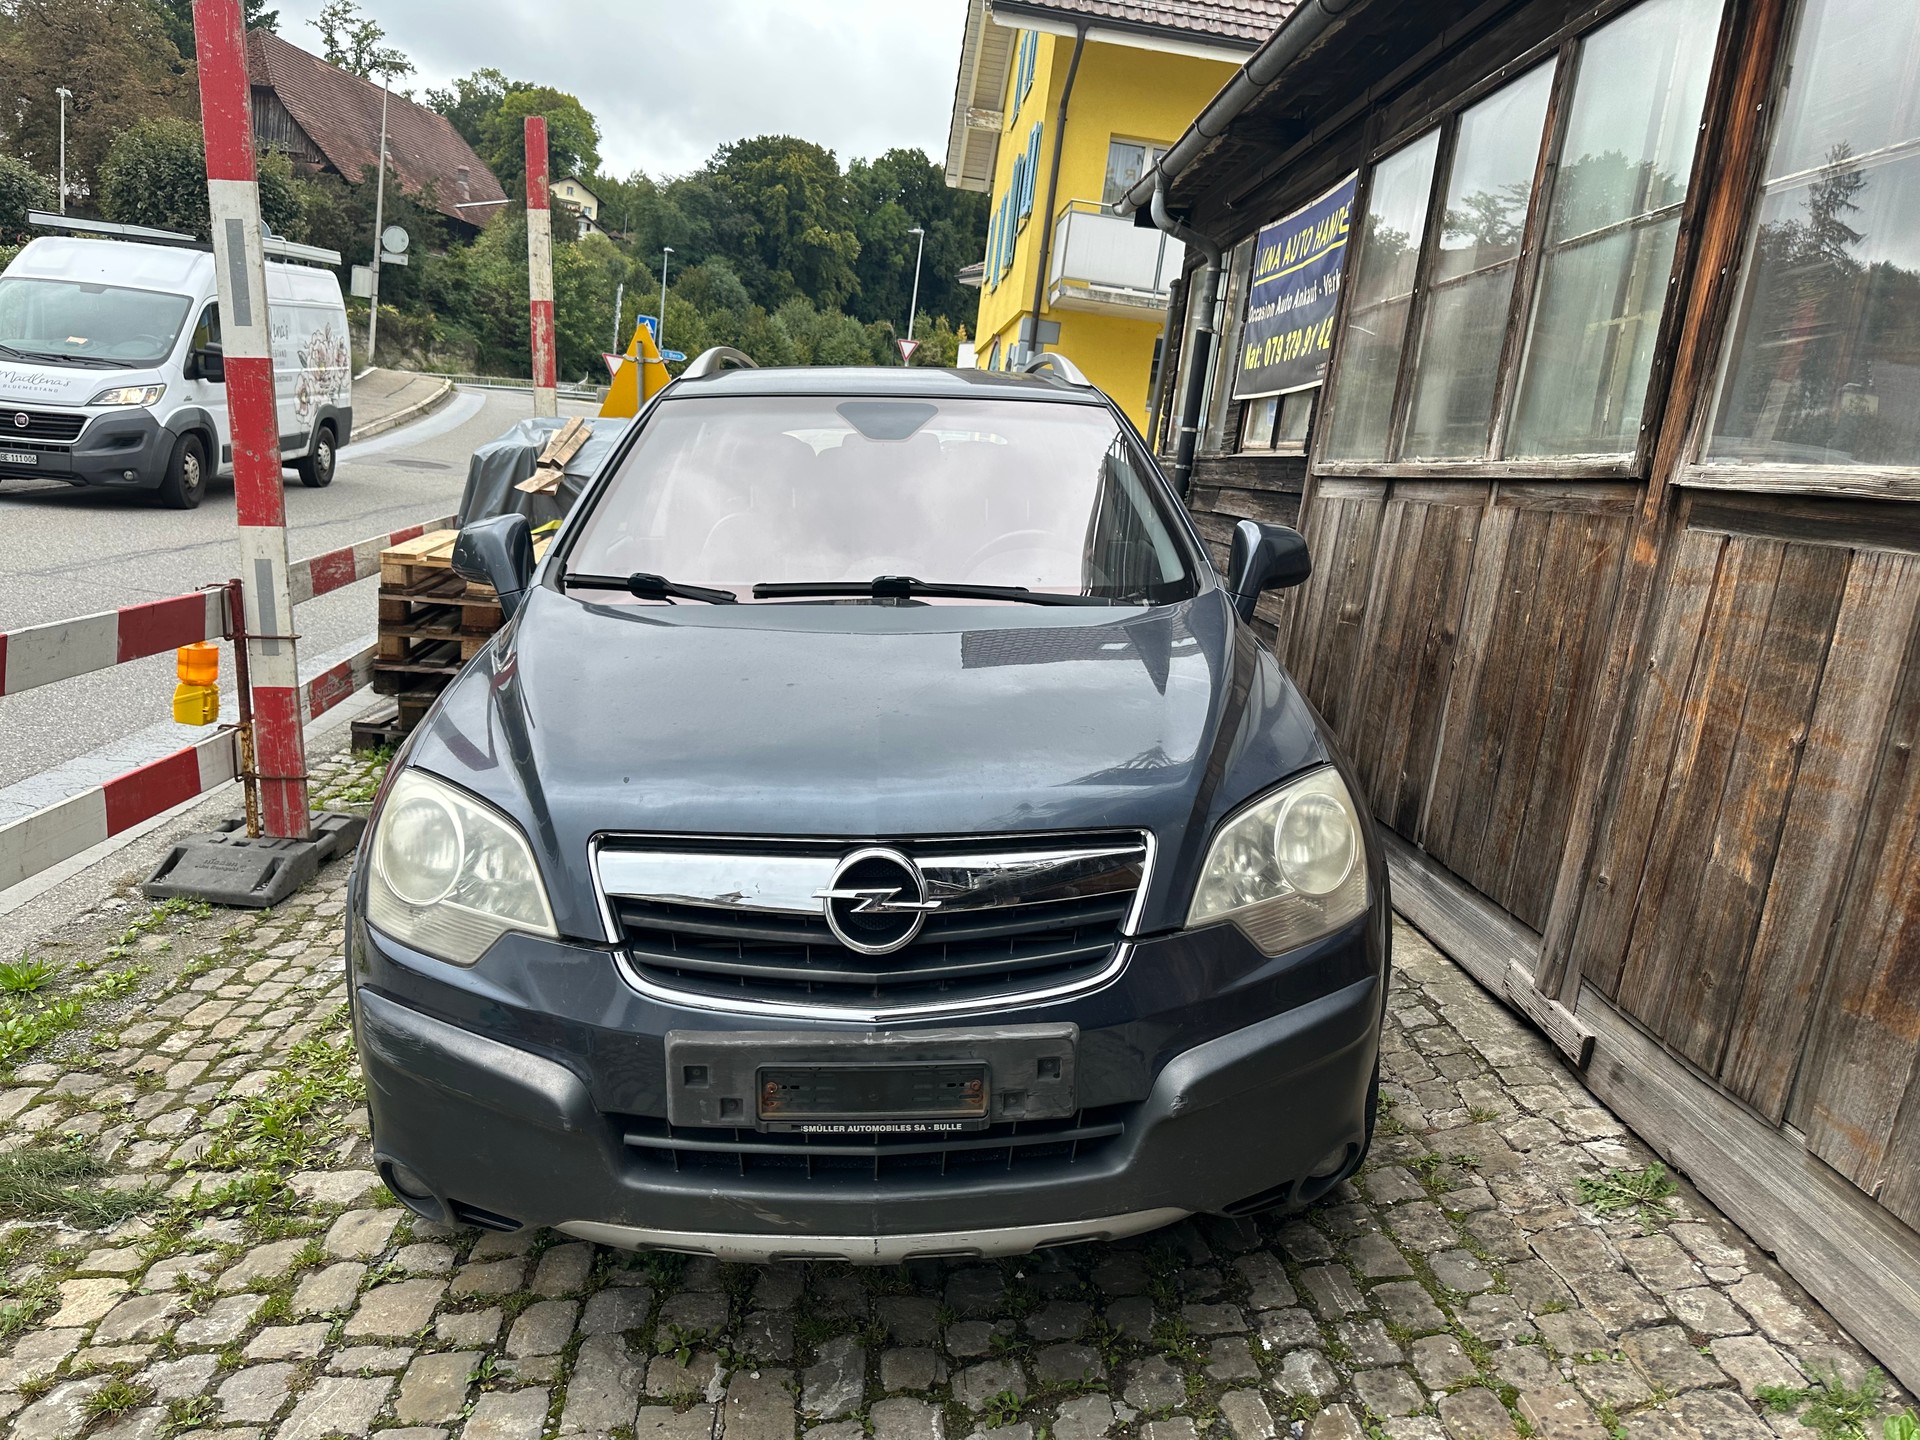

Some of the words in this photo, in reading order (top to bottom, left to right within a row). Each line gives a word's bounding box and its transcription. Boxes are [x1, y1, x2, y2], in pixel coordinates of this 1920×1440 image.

[1282, 225, 1314, 268] AUTO
[1247, 301, 1276, 324] Occasion
[1275, 293, 1293, 316] Auto
[1291, 279, 1318, 310] Ankauf
[1264, 334, 1285, 367] 079
[1283, 328, 1303, 362] 379
[1301, 323, 1319, 357] 91
[1317, 315, 1335, 351] 42
[801, 1123, 845, 1132] SMÜLLER
[847, 1124, 912, 1133] AUTOMOBILES
[914, 1124, 926, 1132] SA
[933, 1123, 963, 1131] BULLE
